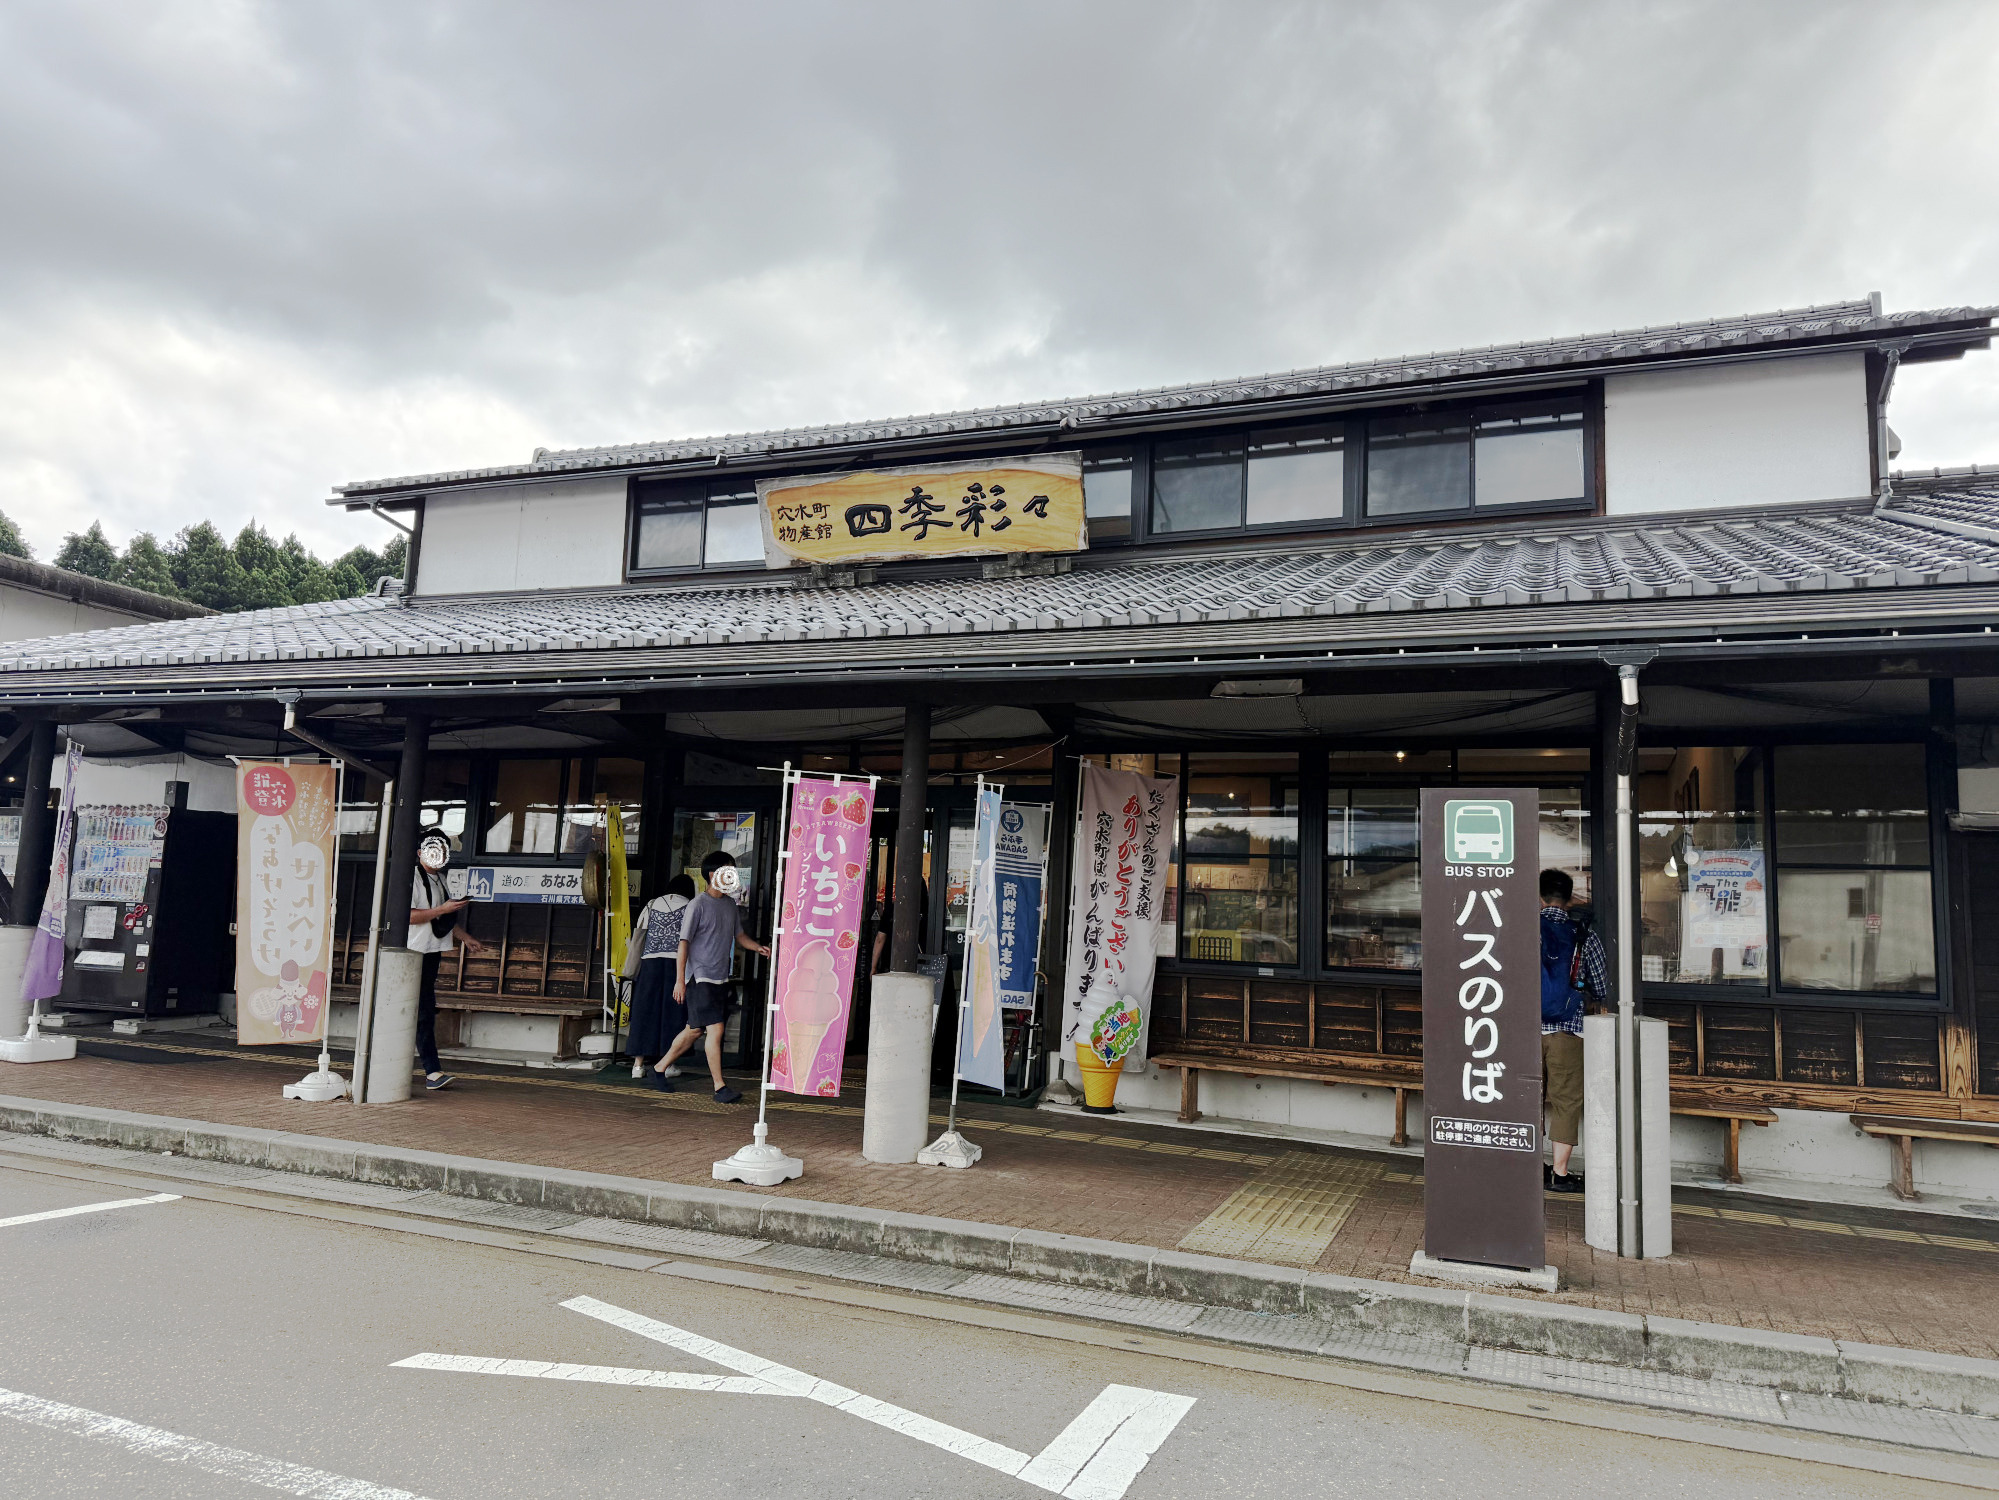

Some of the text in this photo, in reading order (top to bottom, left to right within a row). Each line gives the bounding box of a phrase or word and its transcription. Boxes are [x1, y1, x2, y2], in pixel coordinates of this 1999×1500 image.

[776, 503, 831, 521] 穴水町
[844, 482, 1050, 541] 四季彩々
[778, 523, 833, 543] 物産館
[805, 820, 859, 833] STRAWBERRY
[1135, 789, 1165, 919] たくさんのご支援
[541, 874, 584, 889] あなみ
[1444, 865, 1515, 879] BUS STOP
[793, 851, 812, 934] ソフトクリーム
[805, 832, 847, 937] いちご
[1104, 794, 1141, 985] ありがとうござい
[1716, 879, 1739, 888] The
[1455, 887, 1506, 1104] バスのりば
[1103, 1012, 1131, 1042] ご当地
[1435, 1120, 1529, 1137] バス専用のりばにつき
[1435, 1131, 1532, 1149] 駐停車ご遠慮ください。
